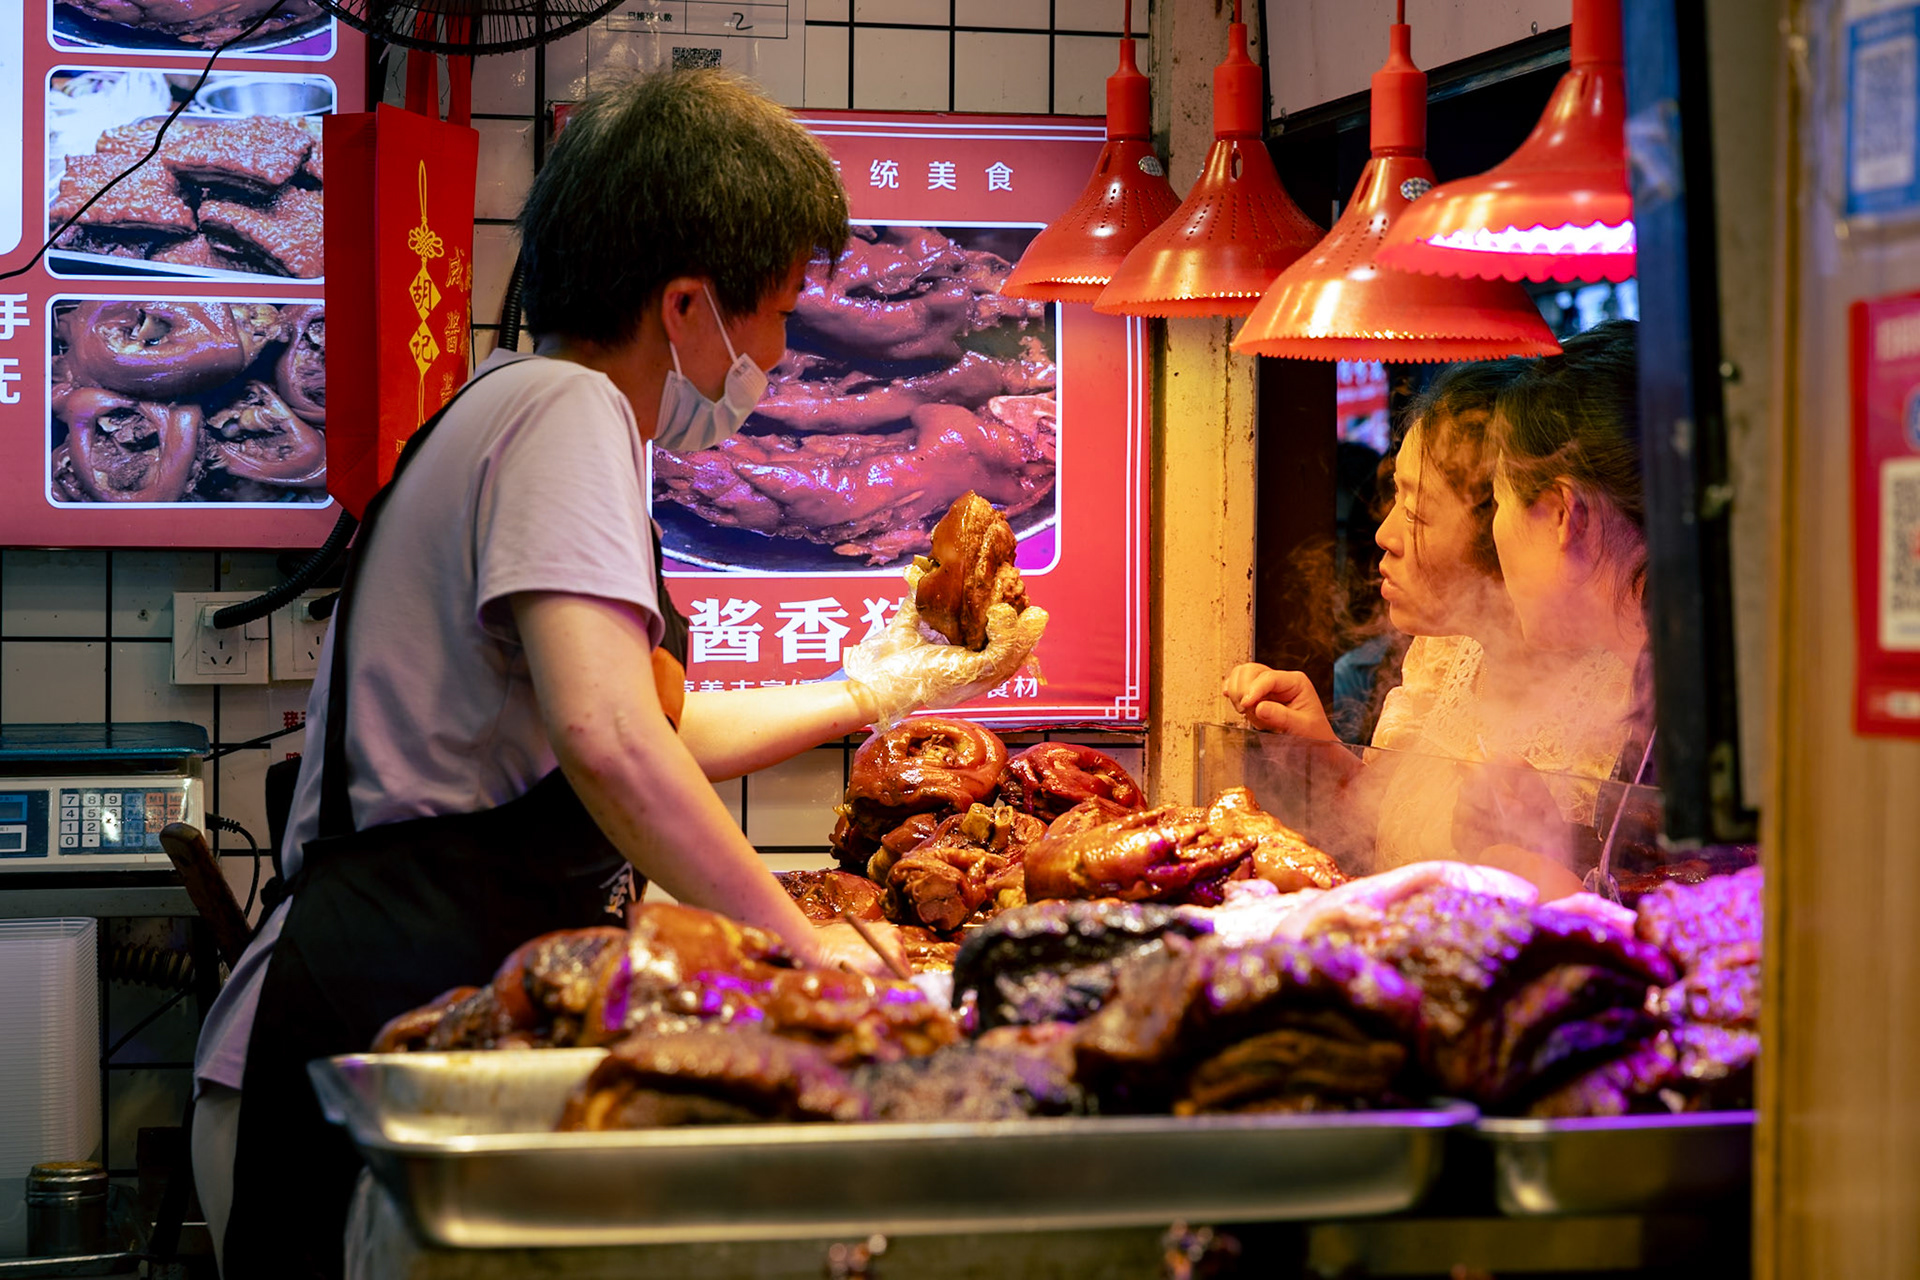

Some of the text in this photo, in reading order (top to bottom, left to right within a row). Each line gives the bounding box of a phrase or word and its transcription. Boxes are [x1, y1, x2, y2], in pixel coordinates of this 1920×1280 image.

[732, 12, 753, 31] 2
[832, 158, 1014, 192] 统美食
[66, 796, 76, 805] 7
[88, 795, 96, 805] 8
[109, 795, 118, 805] 9
[66, 809, 75, 818] 4
[87, 809, 96, 818] 5
[68, 822, 73, 832] 1
[87, 822, 96, 832] 2
[65, 836, 75, 846] 0
